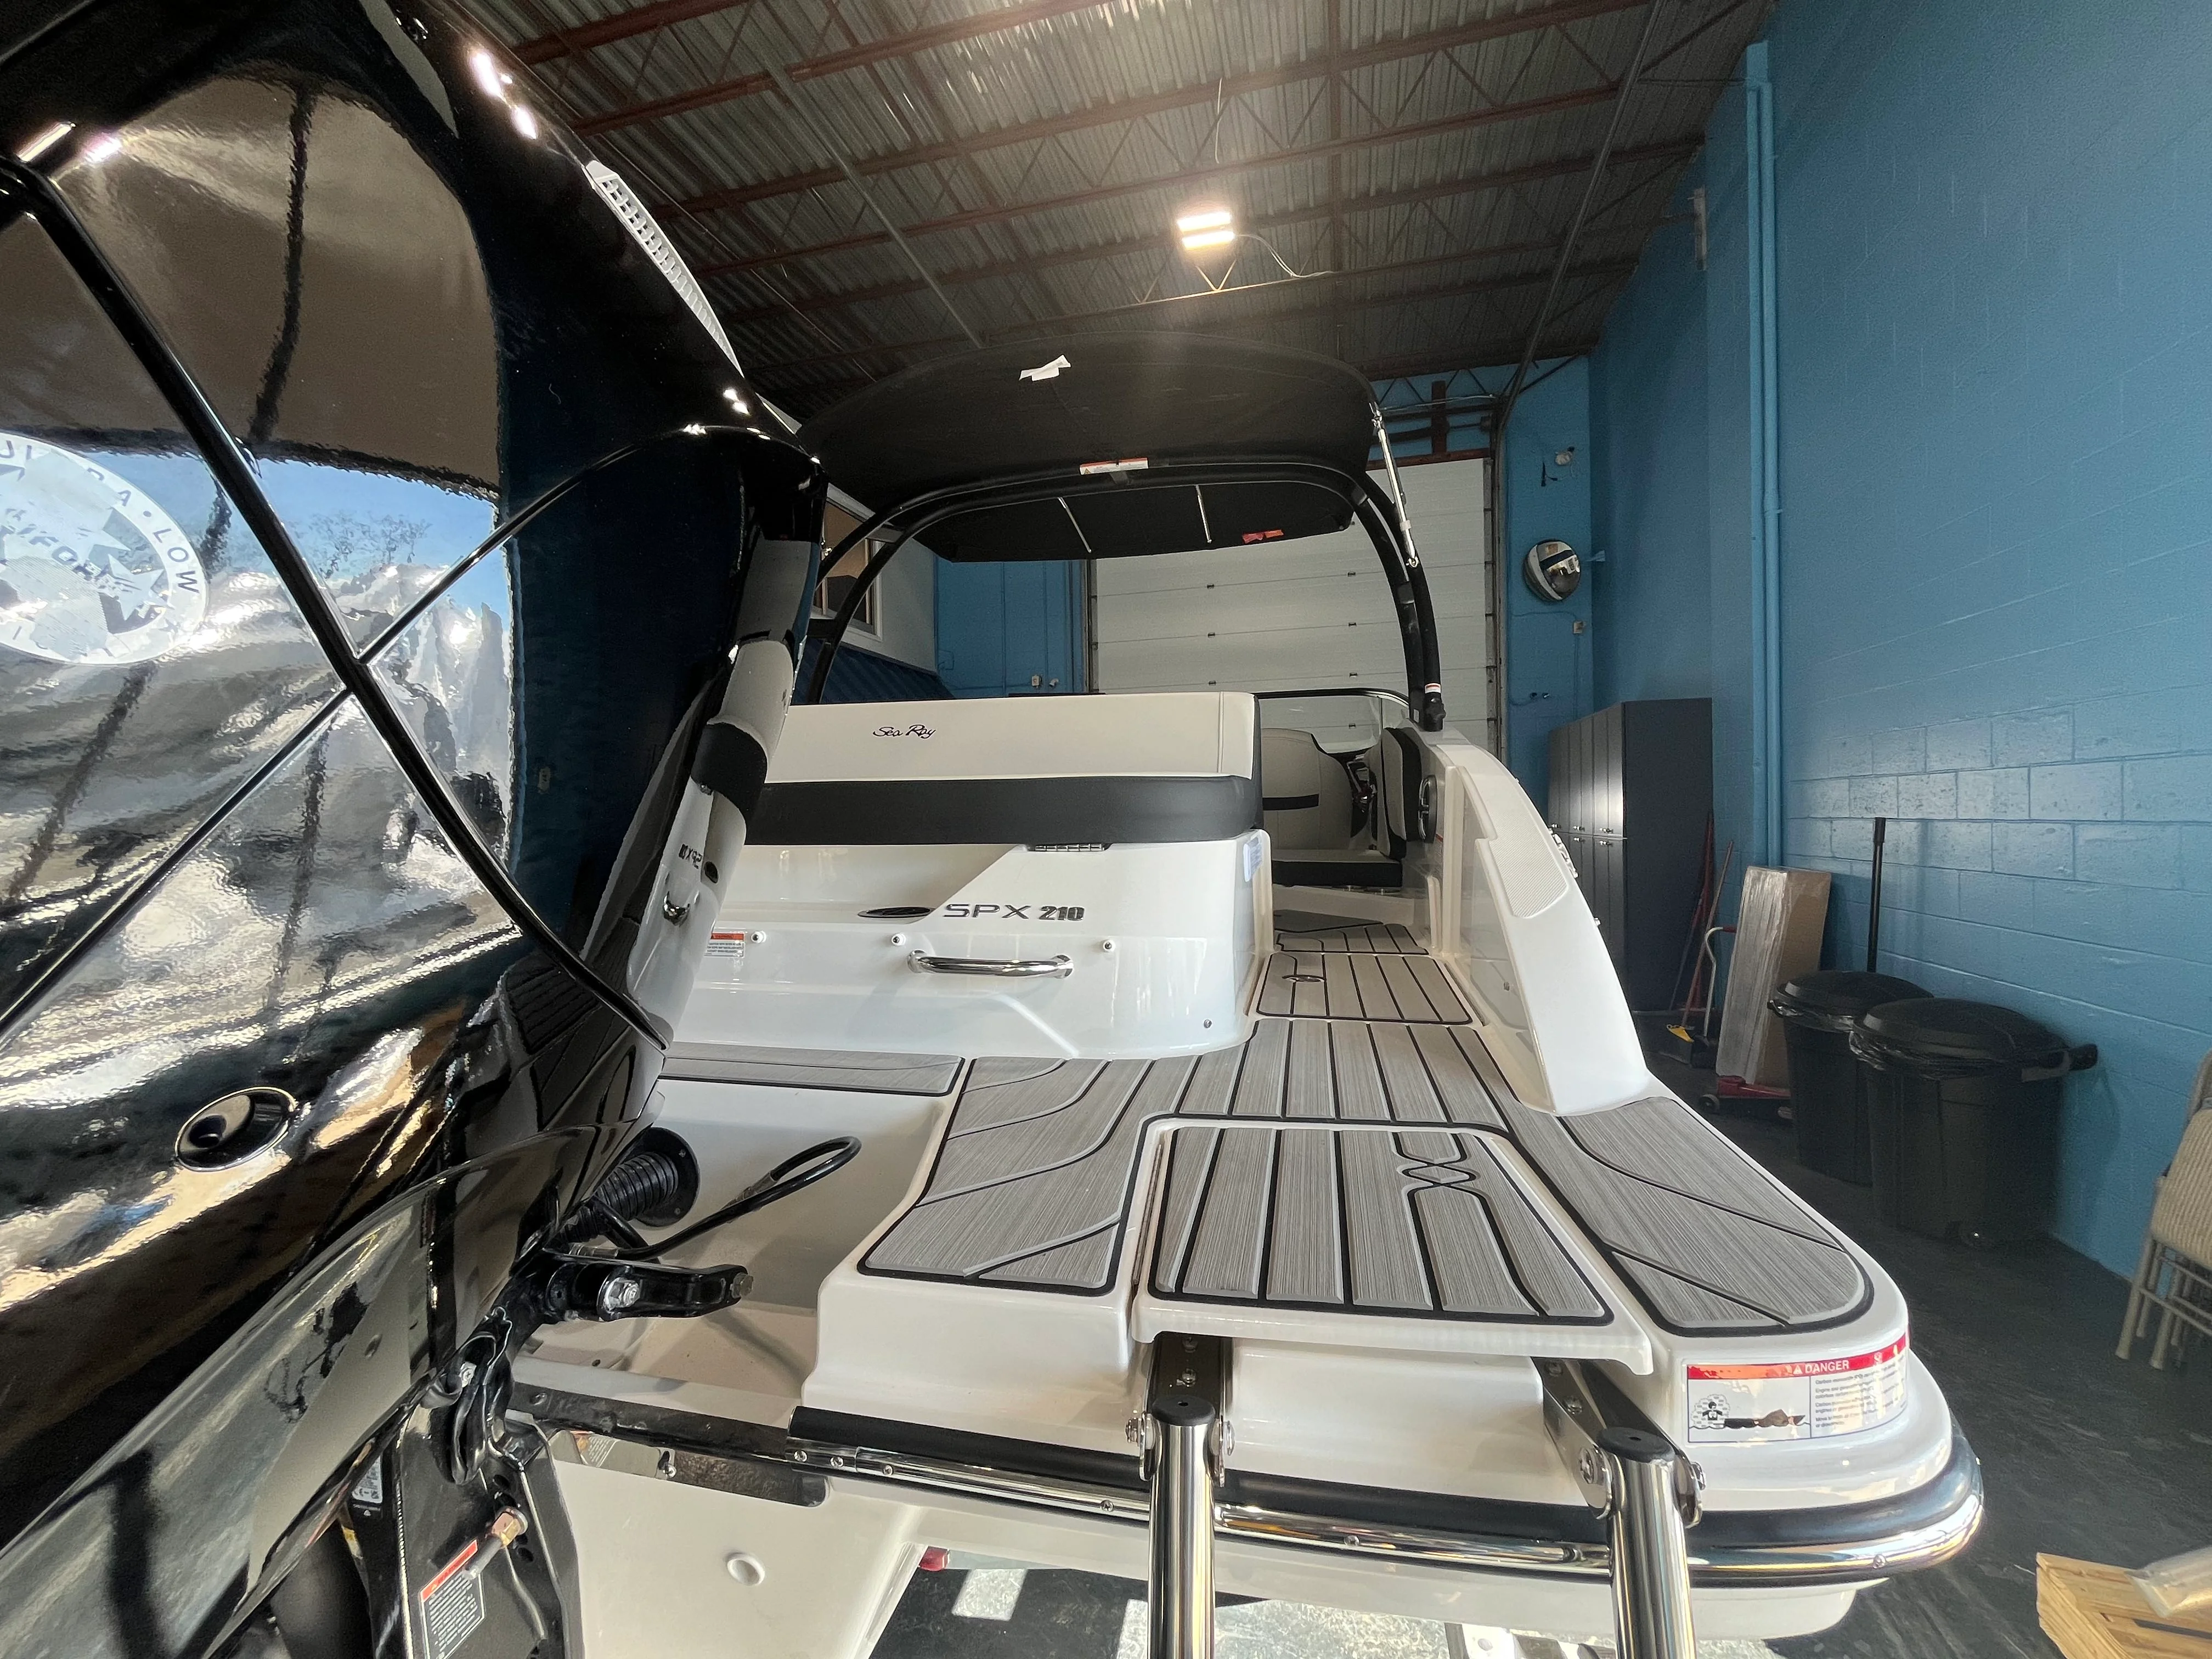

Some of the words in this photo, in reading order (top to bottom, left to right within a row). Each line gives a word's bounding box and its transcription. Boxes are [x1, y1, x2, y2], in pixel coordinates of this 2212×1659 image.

[873, 726, 903, 737] Sea
[905, 724, 936, 738] Ray
[943, 904, 1031, 919] SPX
[1039, 905, 1085, 921] 210
[1805, 1360, 1849, 1374] DANGER
